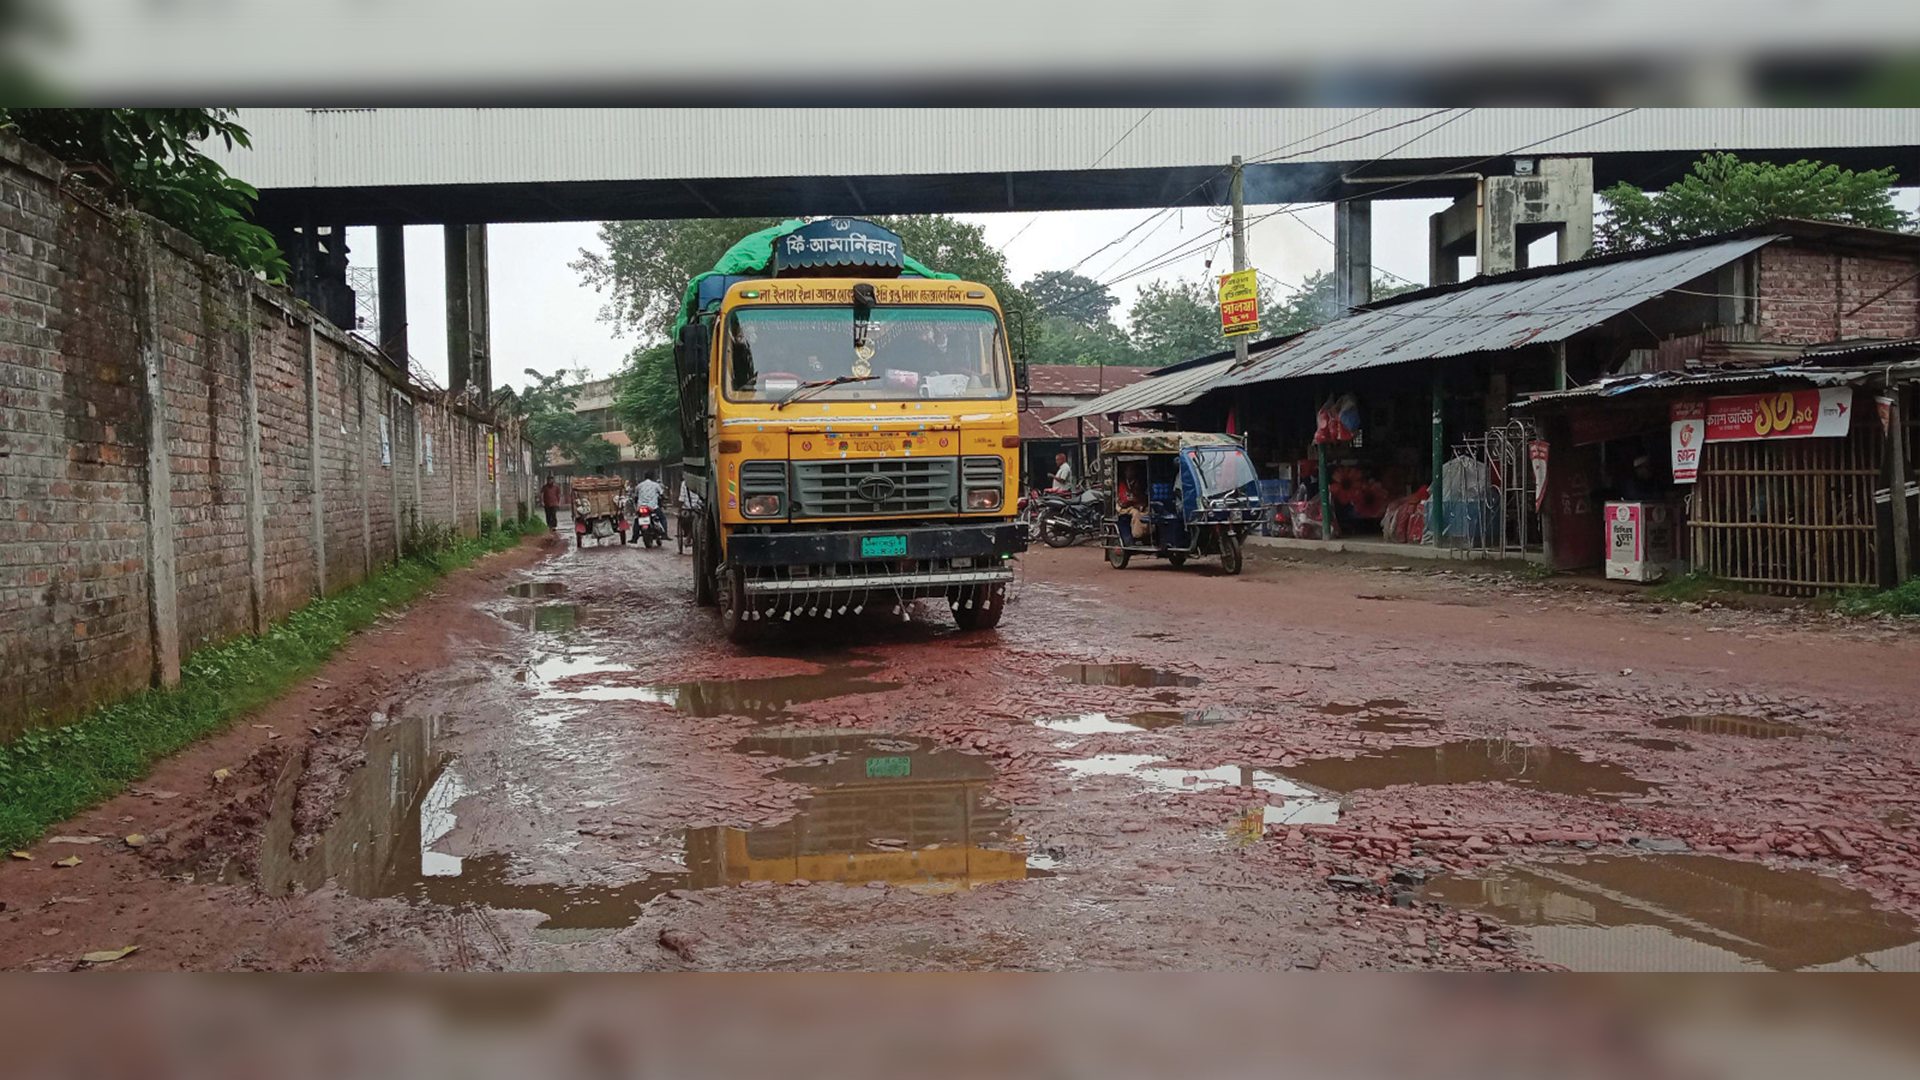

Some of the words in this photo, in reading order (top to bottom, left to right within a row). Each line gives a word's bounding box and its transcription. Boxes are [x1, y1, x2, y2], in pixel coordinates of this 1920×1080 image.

[759, 289, 771, 302] লা
[1706, 413, 1727, 426] ক্যাশ
[1727, 408, 1753, 424] আউট
[854, 440, 896, 451] TATA
[1677, 449, 1696, 463] নগদ
